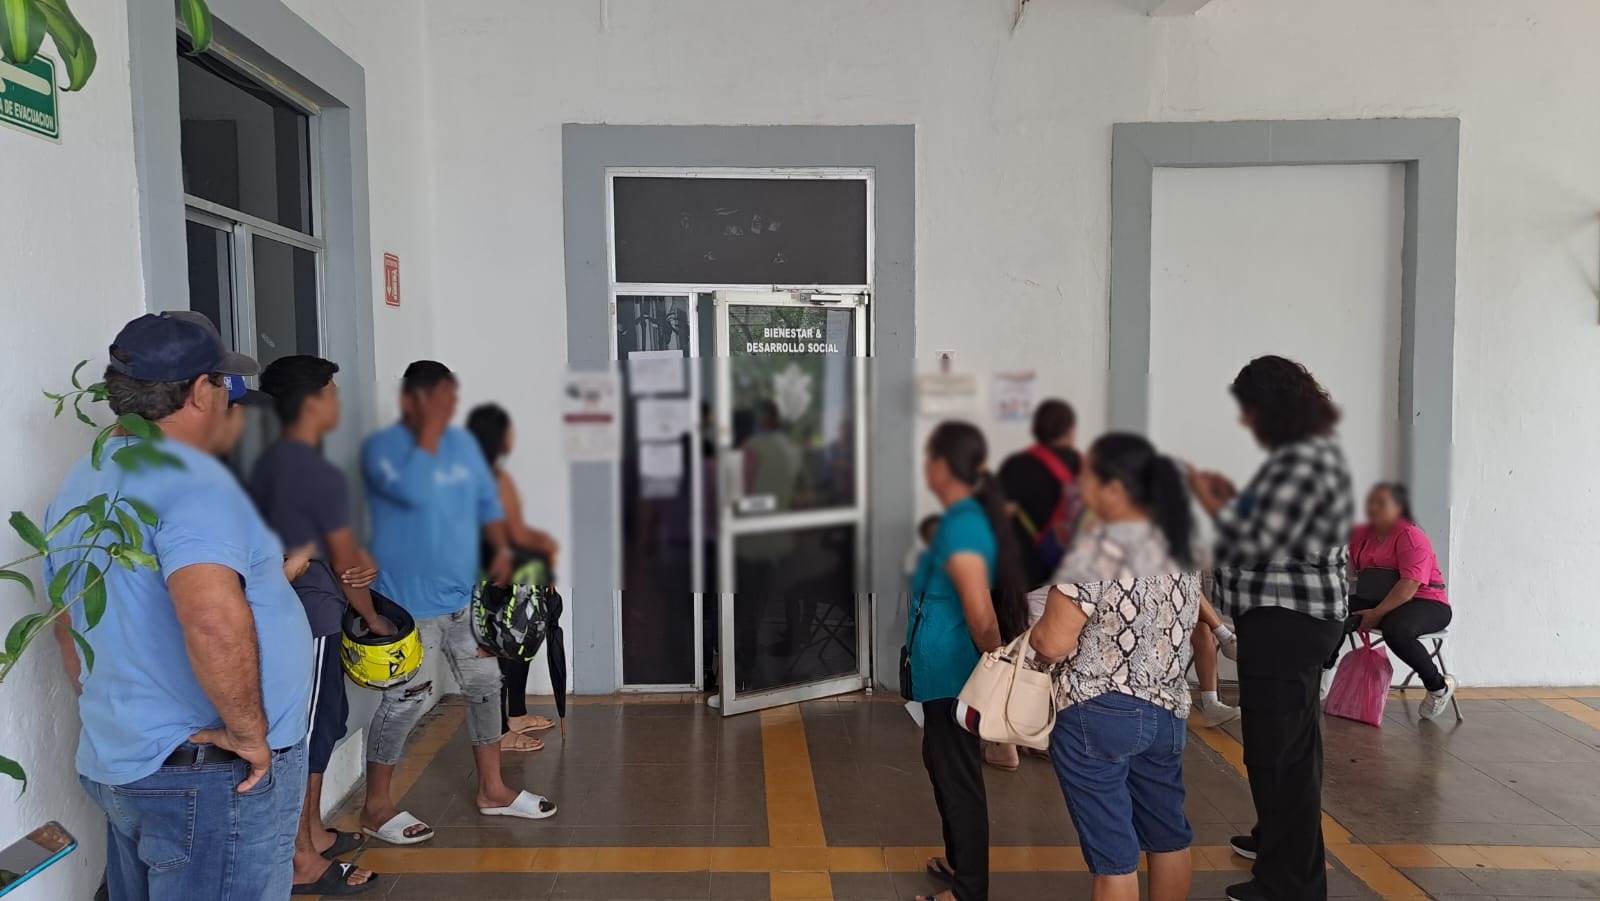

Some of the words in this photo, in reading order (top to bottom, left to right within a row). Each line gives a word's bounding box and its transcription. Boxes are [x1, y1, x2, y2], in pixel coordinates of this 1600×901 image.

[4, 99, 14, 116] DE
[764, 327, 813, 339] BIENESTAR
[815, 328, 822, 339] &
[746, 342, 805, 353] DESARROLLO
[807, 342, 839, 353] SOCIAL
